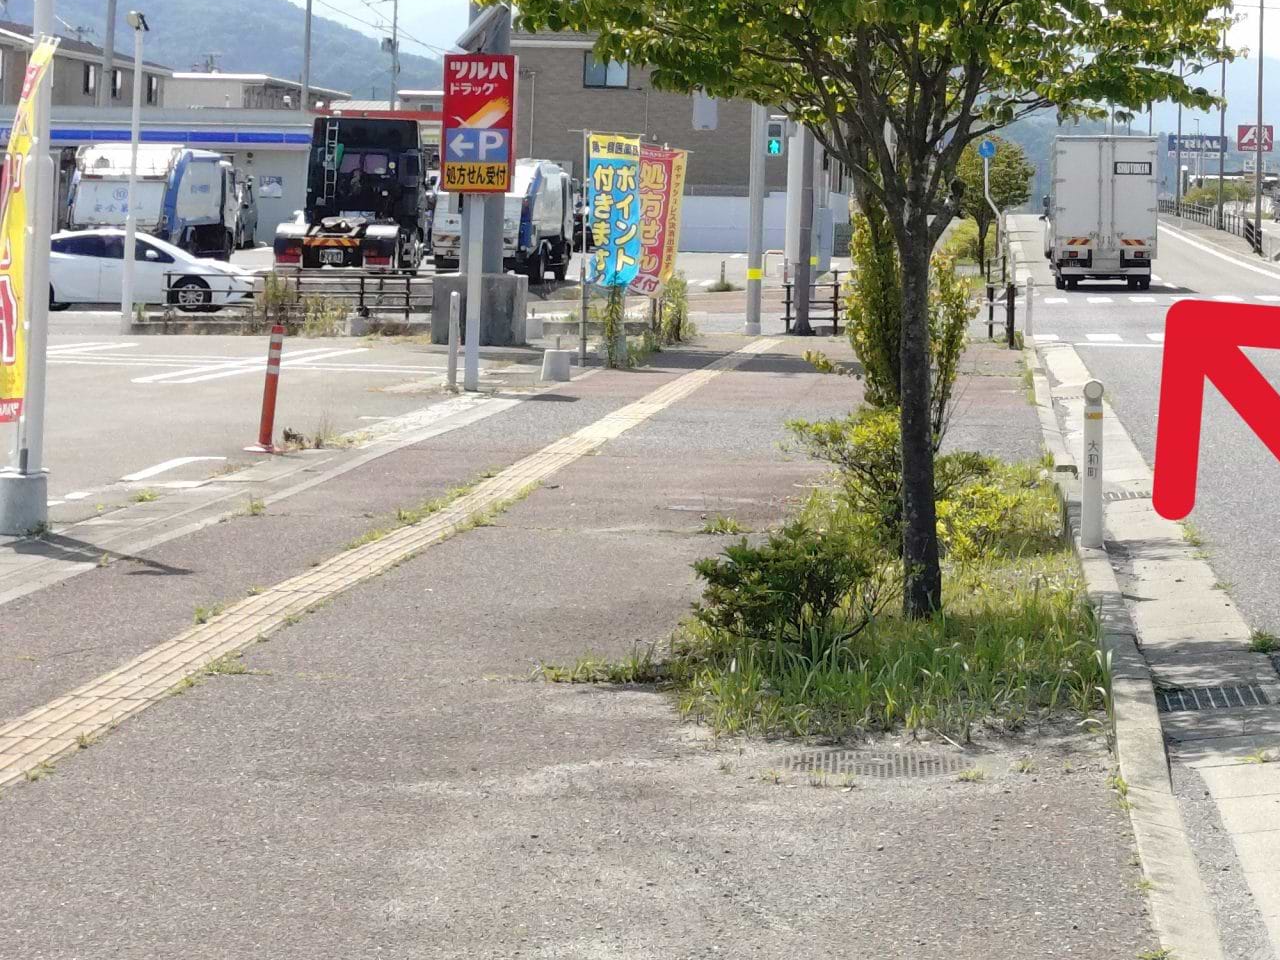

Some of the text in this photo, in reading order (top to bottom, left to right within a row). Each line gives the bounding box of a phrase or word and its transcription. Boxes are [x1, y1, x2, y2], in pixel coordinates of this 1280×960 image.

[450, 61, 508, 80] ツルハ
[450, 83, 498, 96] ドラッグ
[478, 130, 504, 160] P
[446, 165, 506, 186] 処方せん受付
[615, 164, 638, 272] ポイント
